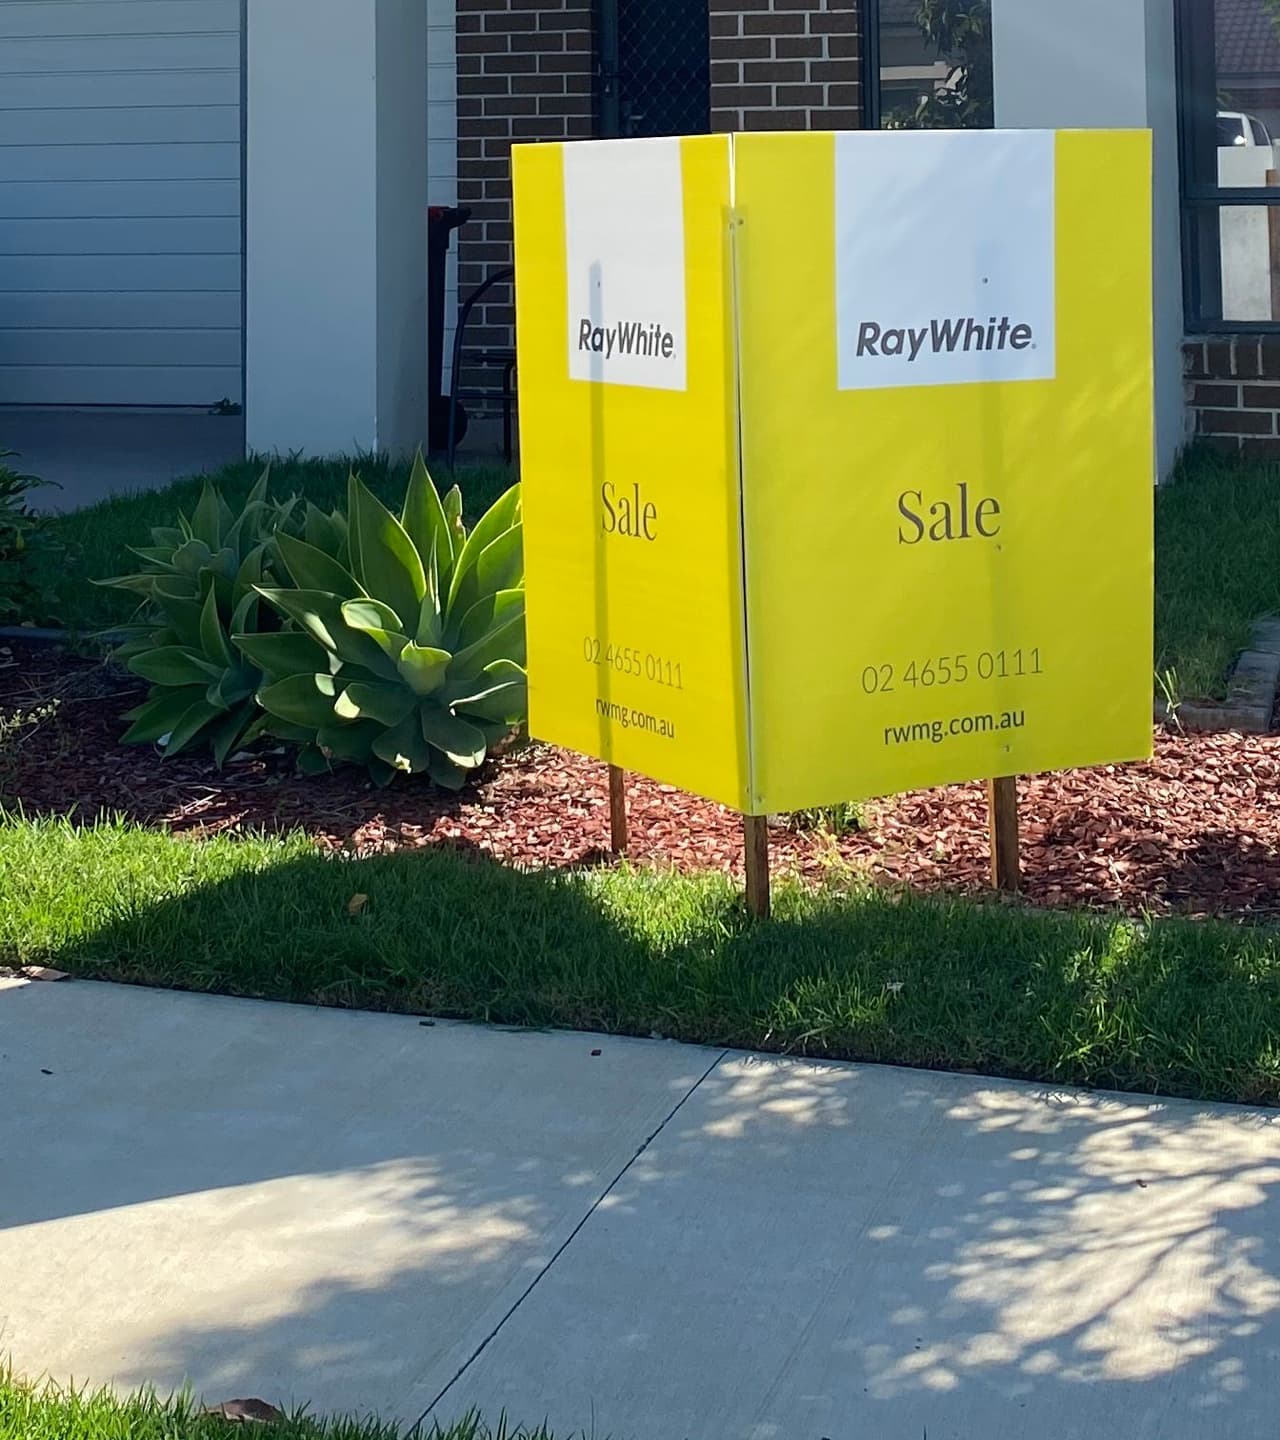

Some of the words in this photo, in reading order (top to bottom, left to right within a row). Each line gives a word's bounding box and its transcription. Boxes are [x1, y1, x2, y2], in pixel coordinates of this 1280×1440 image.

[601, 481, 658, 542] Sale
[898, 481, 1002, 546] Sale
[583, 636, 602, 665] 02
[605, 642, 642, 677] 4655
[645, 653, 684, 690] 0111
[861, 663, 895, 696] 02
[901, 655, 968, 689] 4655
[977, 646, 1044, 681] 0111
[595, 697, 676, 740] rwmg.com.au
[884, 709, 1026, 746] rwmg.com.au
